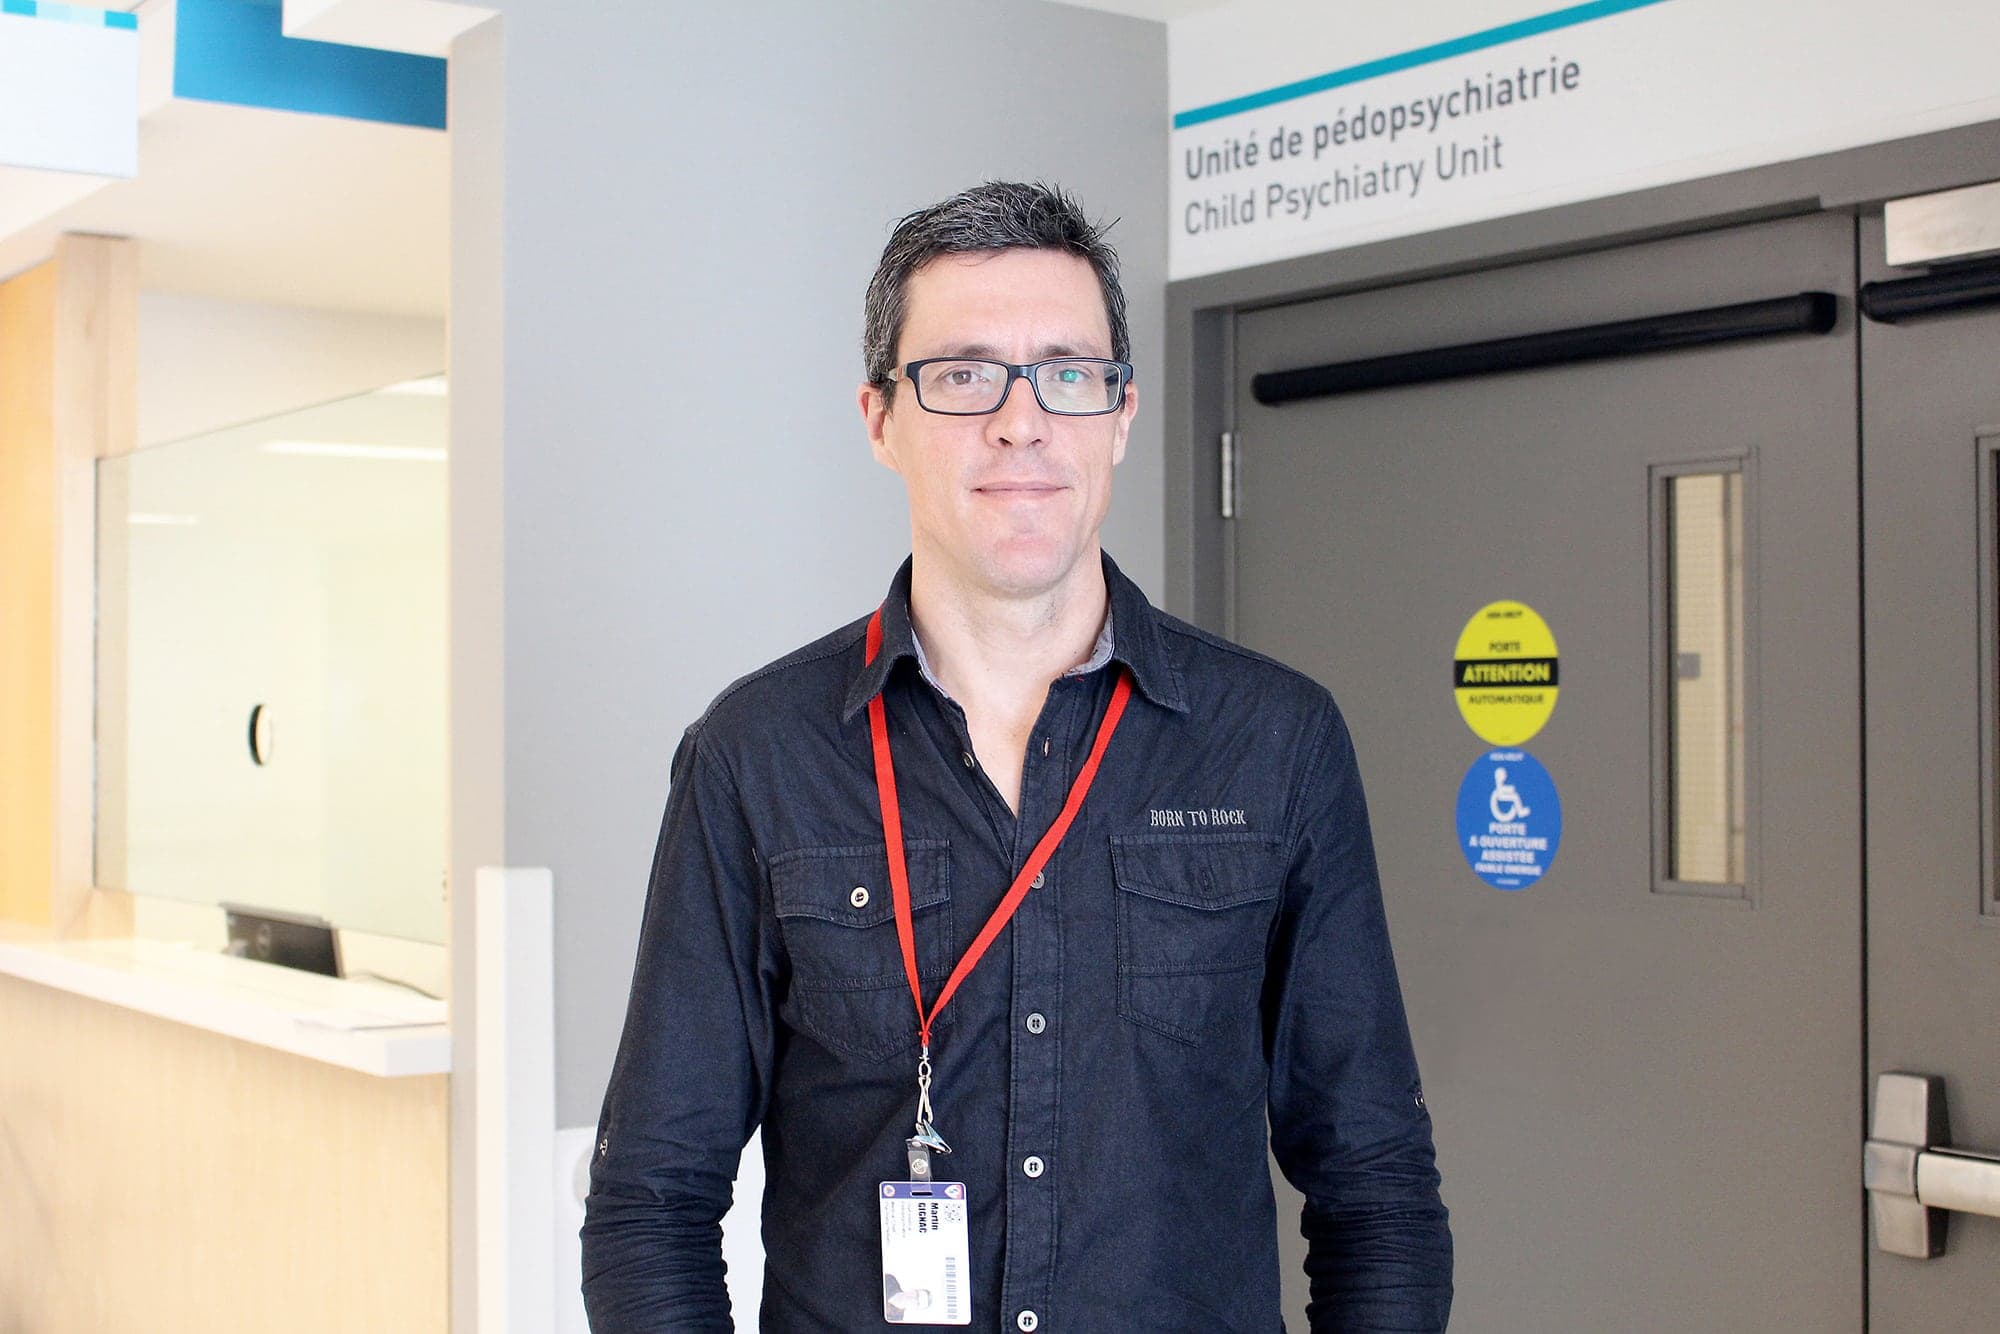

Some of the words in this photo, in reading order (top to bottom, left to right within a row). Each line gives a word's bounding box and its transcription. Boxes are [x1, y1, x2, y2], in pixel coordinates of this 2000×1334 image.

[1186, 131, 1258, 180] Unité
[1269, 127, 1302, 161] de
[1313, 56, 1580, 159] pédopsychiatrie
[1184, 189, 1254, 236] Child
[1266, 158, 1425, 220] Psychiatry
[1436, 134, 1504, 181] Unit
[1489, 641, 1520, 652] PORTE
[1463, 662, 1551, 682] ATTENTION
[1469, 693, 1543, 704] AUTOMATIQUE
[1150, 809, 1185, 827] BORN
[1187, 809, 1208, 826] TO
[1211, 808, 1247, 825] ROCK
[1489, 822, 1527, 835] PORTE
[1480, 836, 1547, 850] OUVERTURE
[931, 1202, 939, 1231] Martin
